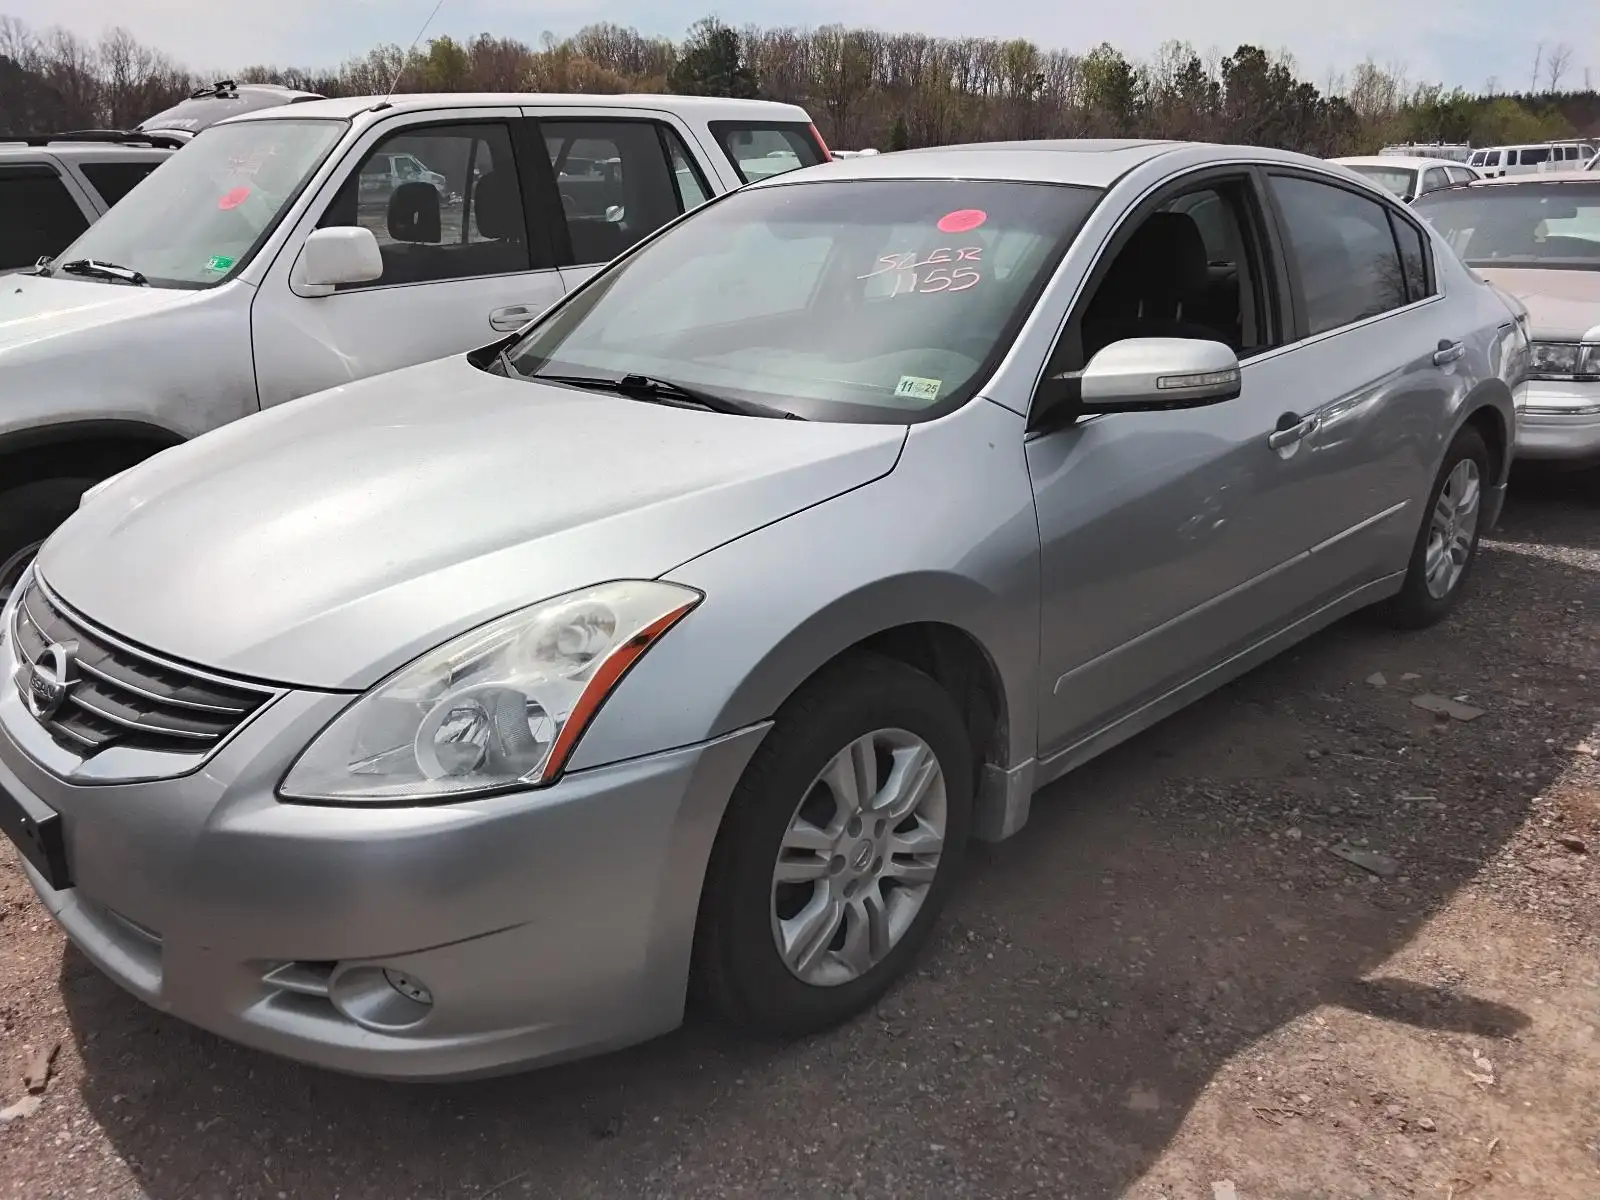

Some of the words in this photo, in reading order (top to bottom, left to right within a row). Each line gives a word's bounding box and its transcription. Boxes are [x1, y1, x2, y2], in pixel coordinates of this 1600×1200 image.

[890, 267, 981, 298] 1155
[901, 381, 914, 392] 11
[925, 383, 938, 394] 25
